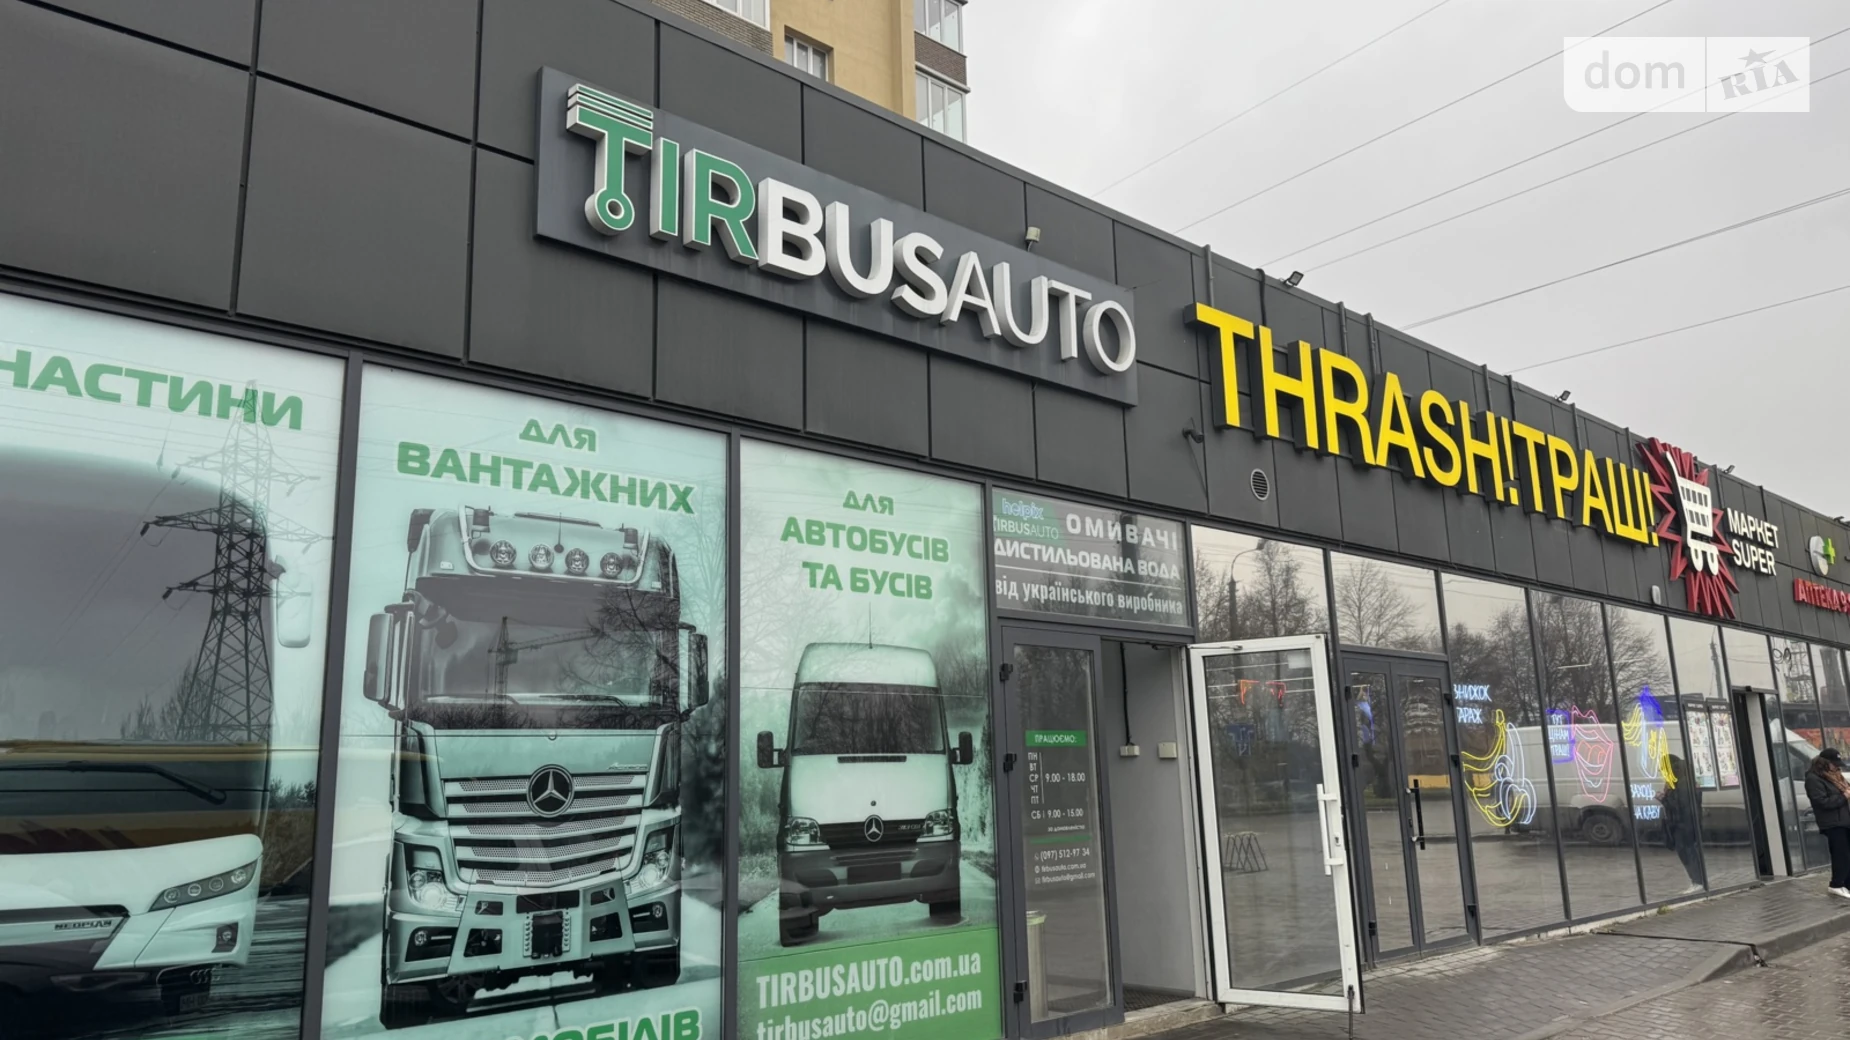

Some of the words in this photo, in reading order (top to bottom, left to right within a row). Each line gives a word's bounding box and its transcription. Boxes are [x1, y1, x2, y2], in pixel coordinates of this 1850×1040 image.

[566, 83, 1136, 375] TIRBUSAUTO
[519, 418, 596, 452] ДЛЯ
[397, 441, 696, 514] ВАНТАЖНИХ
[842, 490, 895, 516] ДЛЯ
[780, 516, 949, 563] АВТОБУСІВ
[1066, 513, 1178, 551] ОМИВАЧІ
[1727, 507, 1779, 548] МАРКЕТ
[994, 538, 1135, 575] ДИСТИЛЬОВАНА
[1138, 560, 1181, 580] ВОДА
[1732, 539, 1777, 576] SUPER
[802, 561, 843, 591] ТА
[850, 567, 933, 600] БУСІВ
[995, 575, 1019, 601] від
[1022, 580, 1114, 608] українського
[1117, 592, 1183, 614] виробника
[1797, 579, 1841, 612] АПТЕКА
[1045, 772, 1061, 782] 9.00
[1047, 809, 1061, 818] 9.00
[756, 952, 982, 1009] TIRBUSAUTO.com.ua
[756, 989, 983, 1040] tirbusauto@gmail.com
